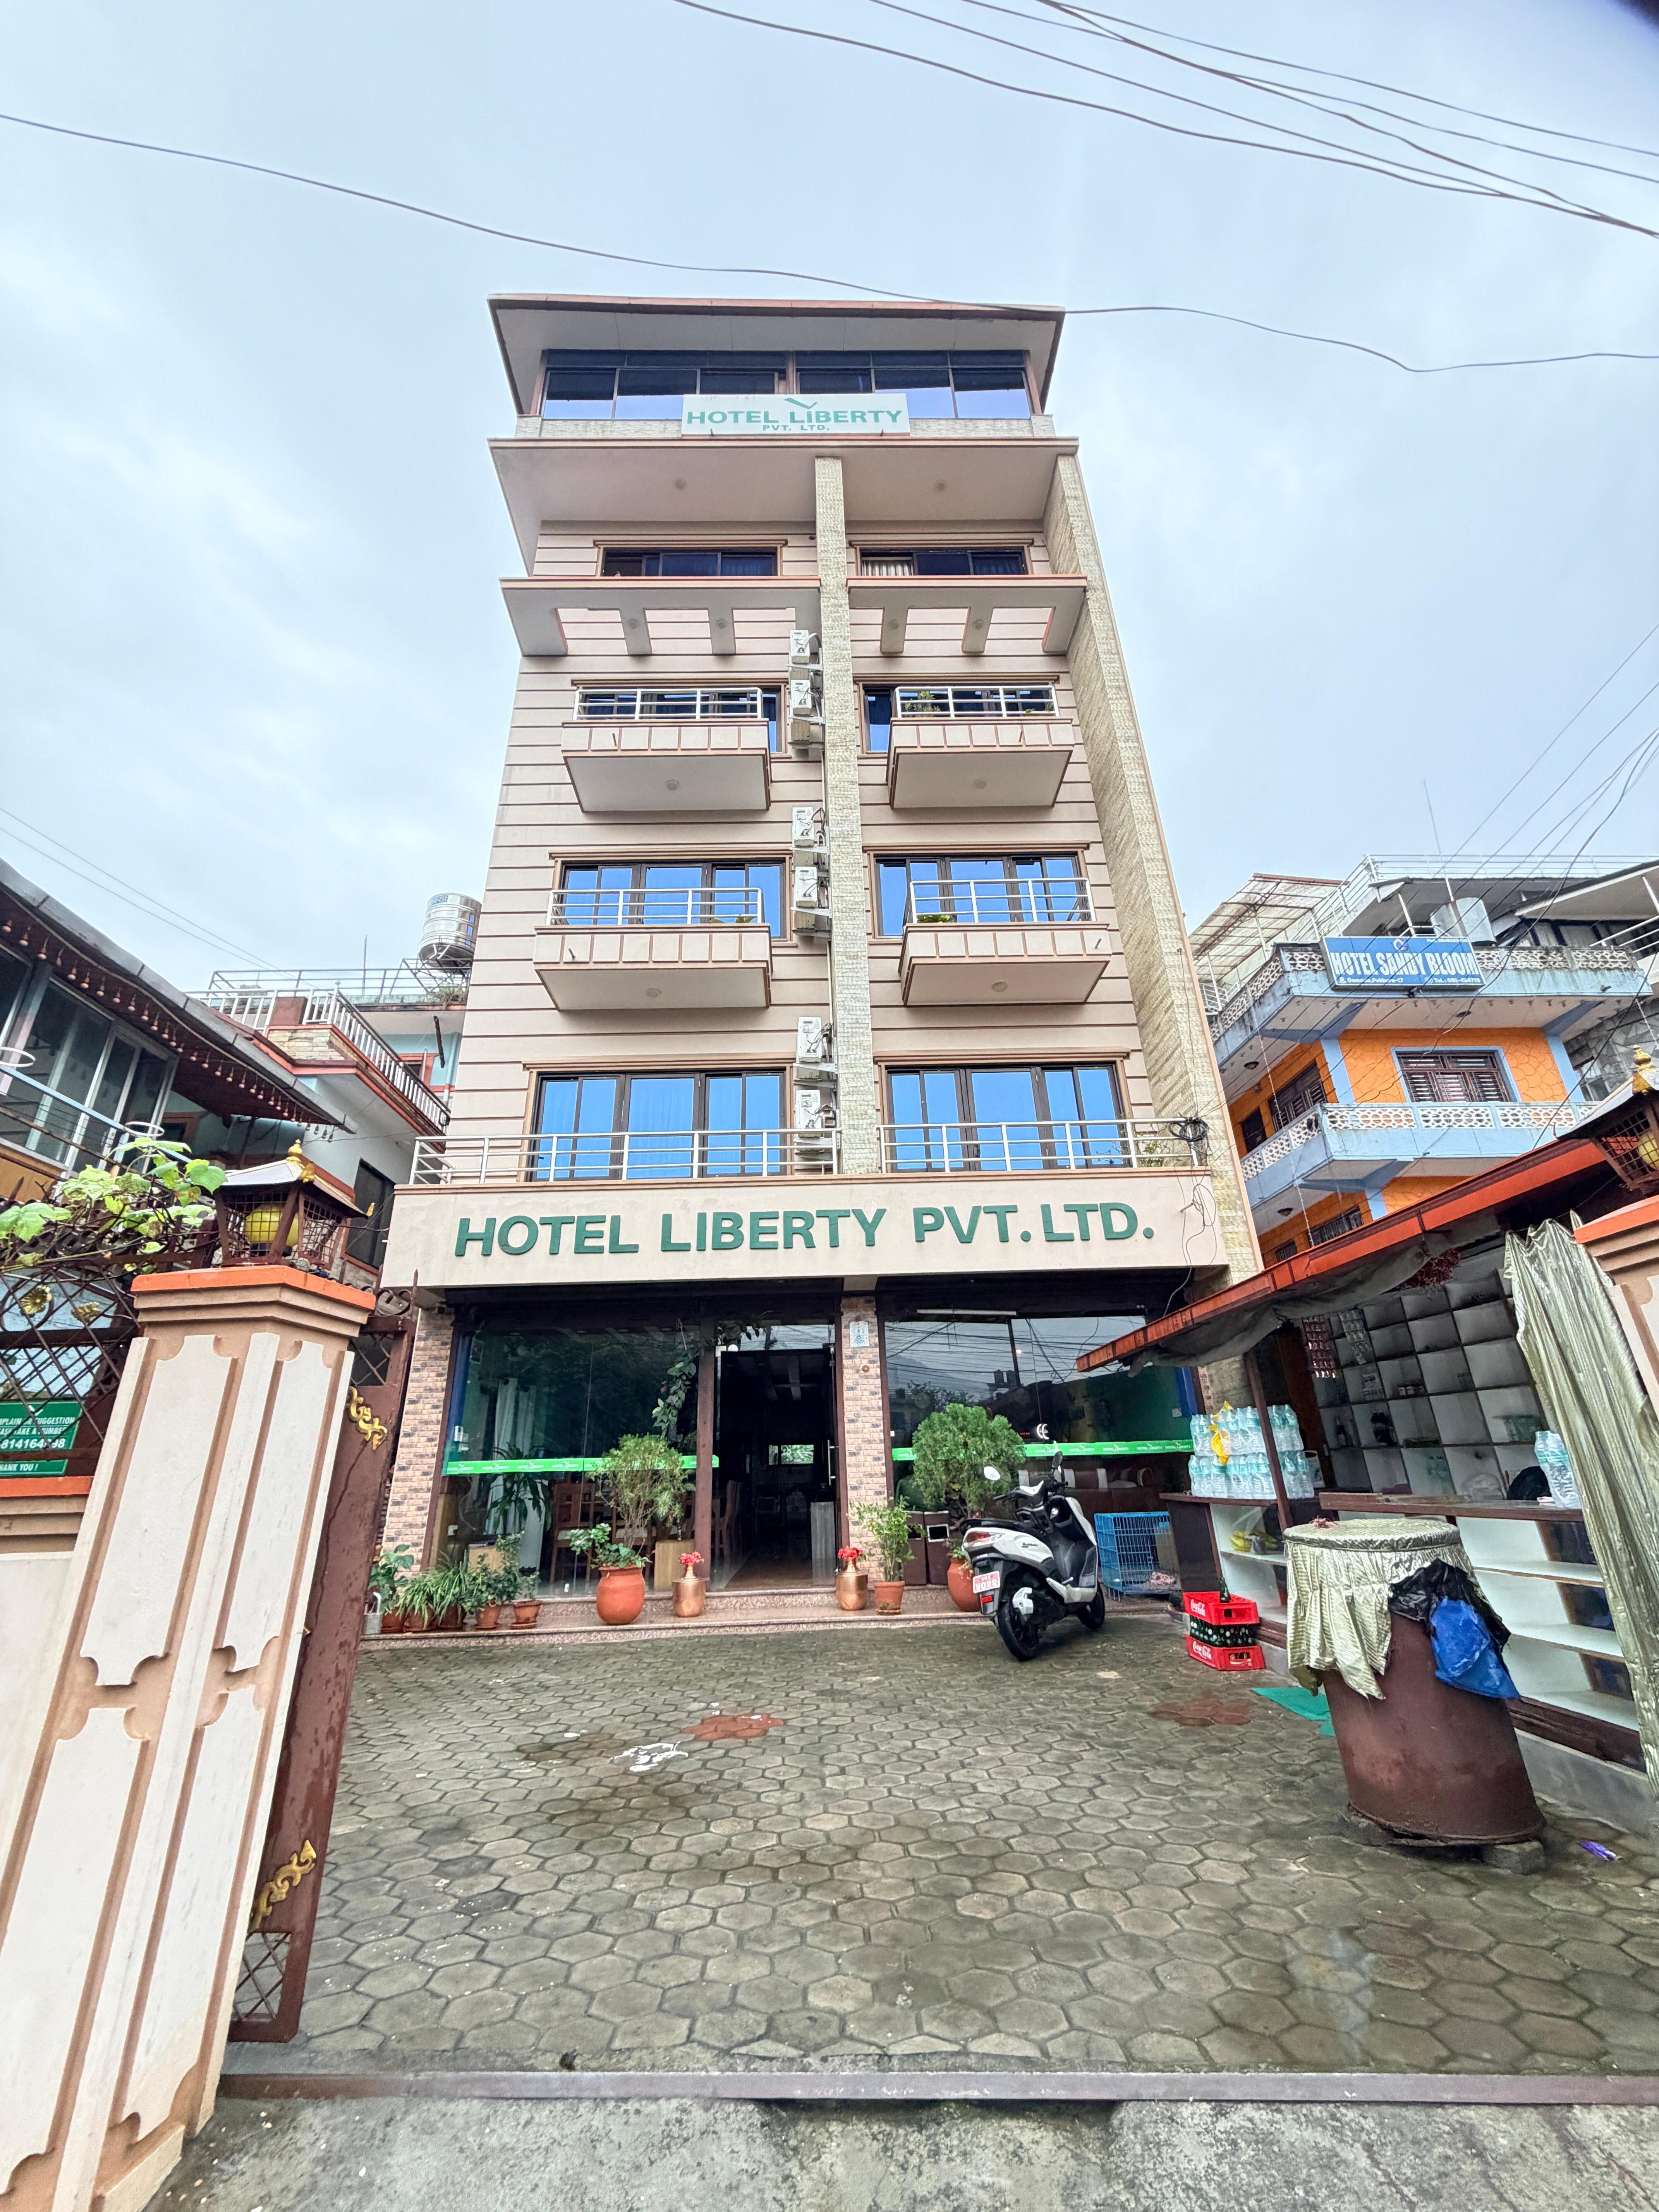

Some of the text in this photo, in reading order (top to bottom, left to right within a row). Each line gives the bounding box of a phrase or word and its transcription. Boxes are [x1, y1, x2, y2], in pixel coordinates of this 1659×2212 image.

[687, 411, 779, 424] HOTEL
[1330, 952, 1480, 975] HOTEL SANDY BLOOM
[455, 1214, 639, 1256] HOTEL
[661, 1208, 887, 1251] LIBERTY
